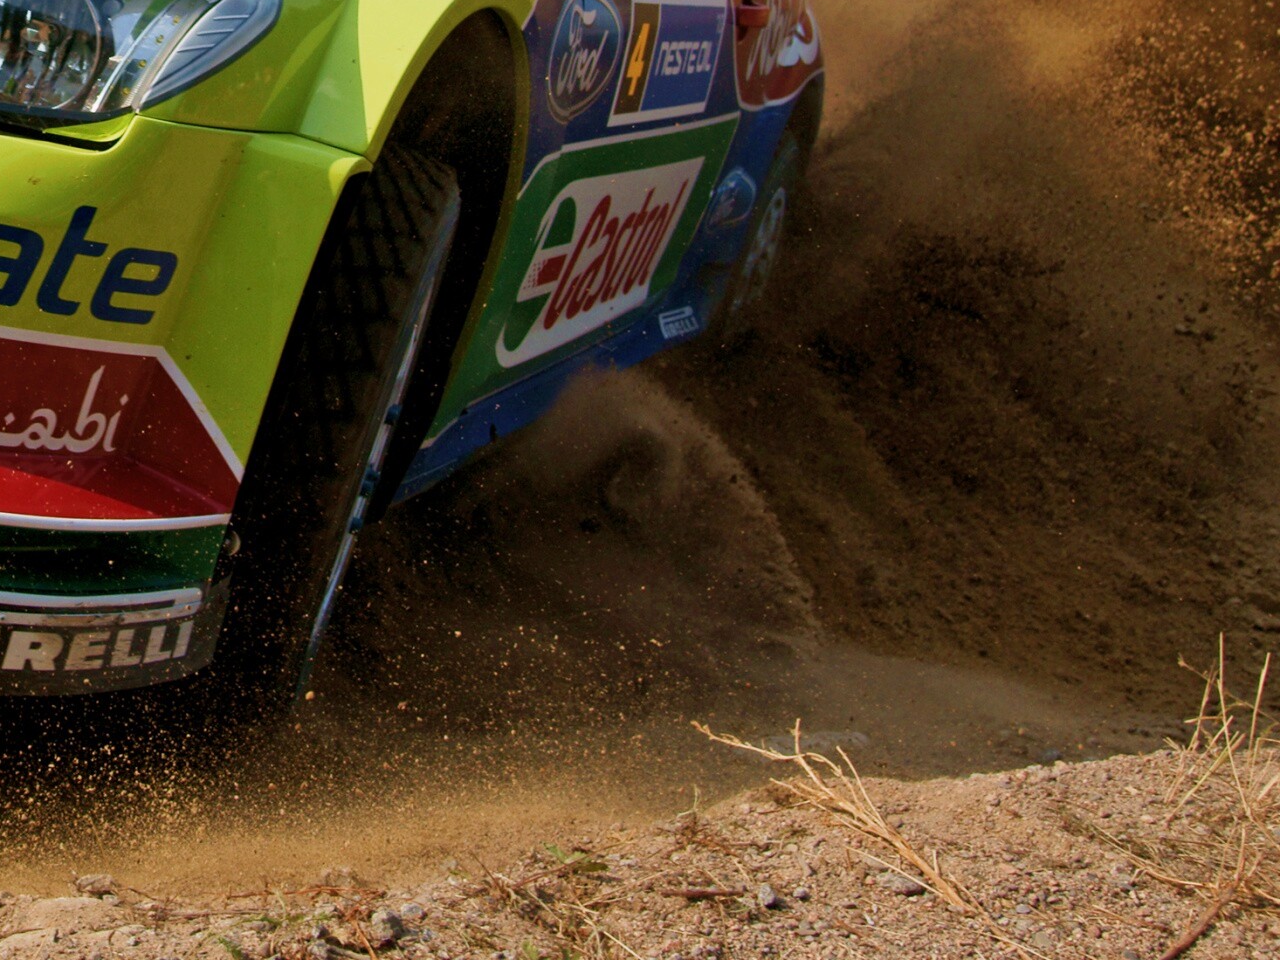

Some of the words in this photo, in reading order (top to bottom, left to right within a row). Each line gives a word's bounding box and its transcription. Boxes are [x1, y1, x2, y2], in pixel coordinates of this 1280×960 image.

[557, 3, 610, 98] Ford
[626, 22, 651, 97] 4
[543, 178, 689, 331] Castrol
